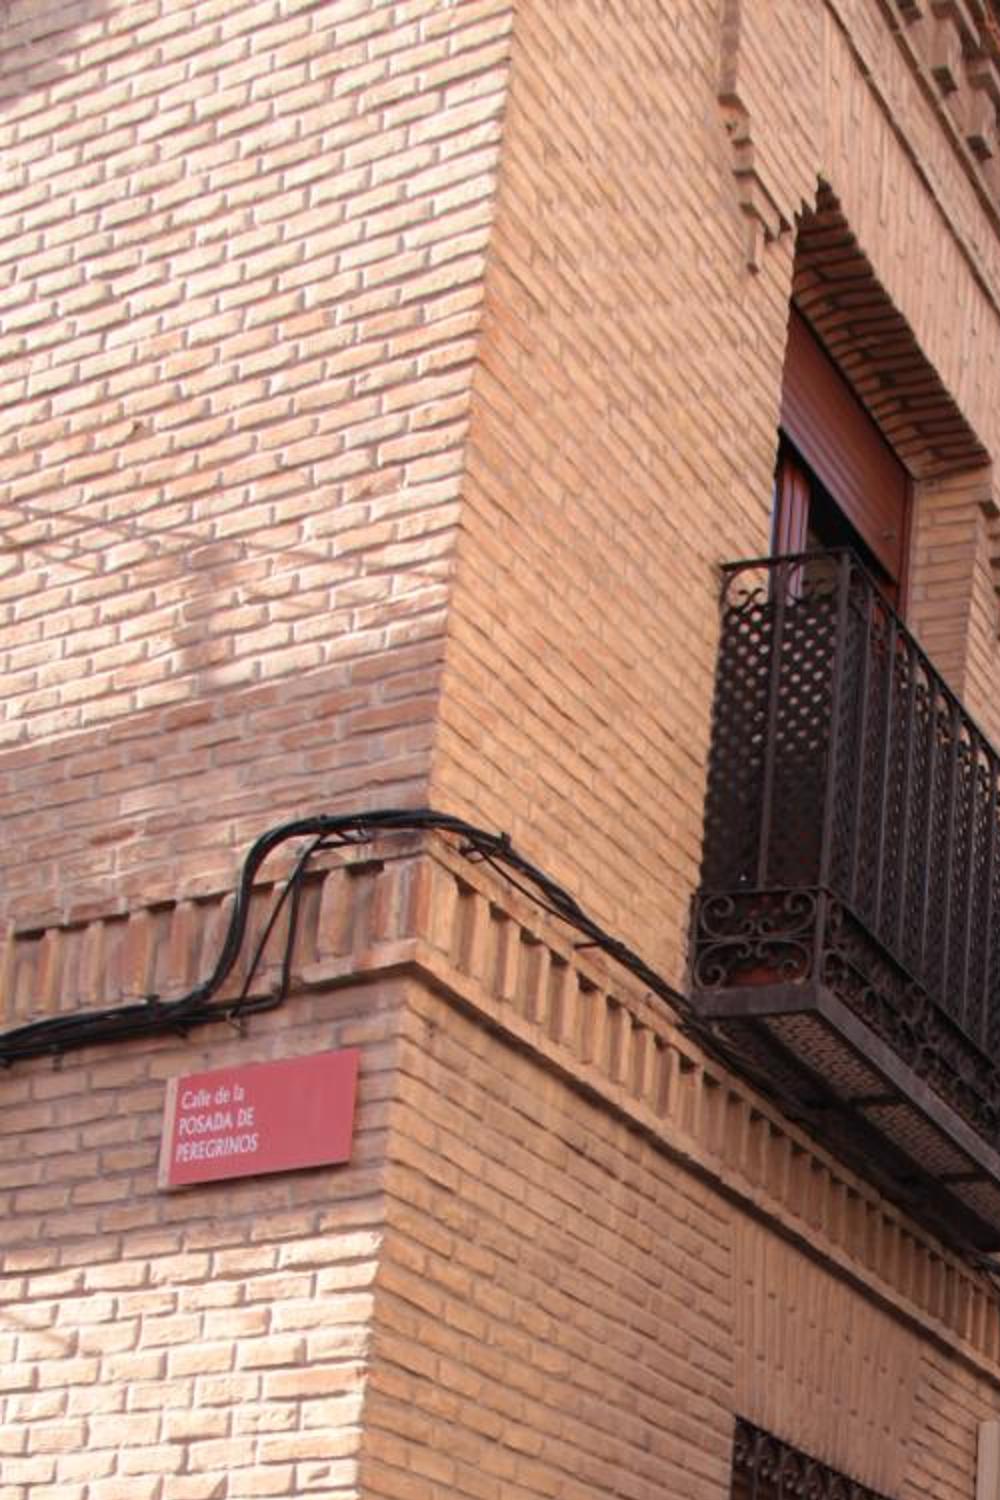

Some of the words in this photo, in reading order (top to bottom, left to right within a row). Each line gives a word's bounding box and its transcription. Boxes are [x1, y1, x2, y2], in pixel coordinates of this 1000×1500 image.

[182, 1089, 210, 1110] Calle
[215, 1086, 230, 1105] de
[233, 1083, 244, 1101] la
[179, 1112, 233, 1136] POSADA
[236, 1107, 255, 1127] DE
[176, 1133, 258, 1162] PEREGRINOS
